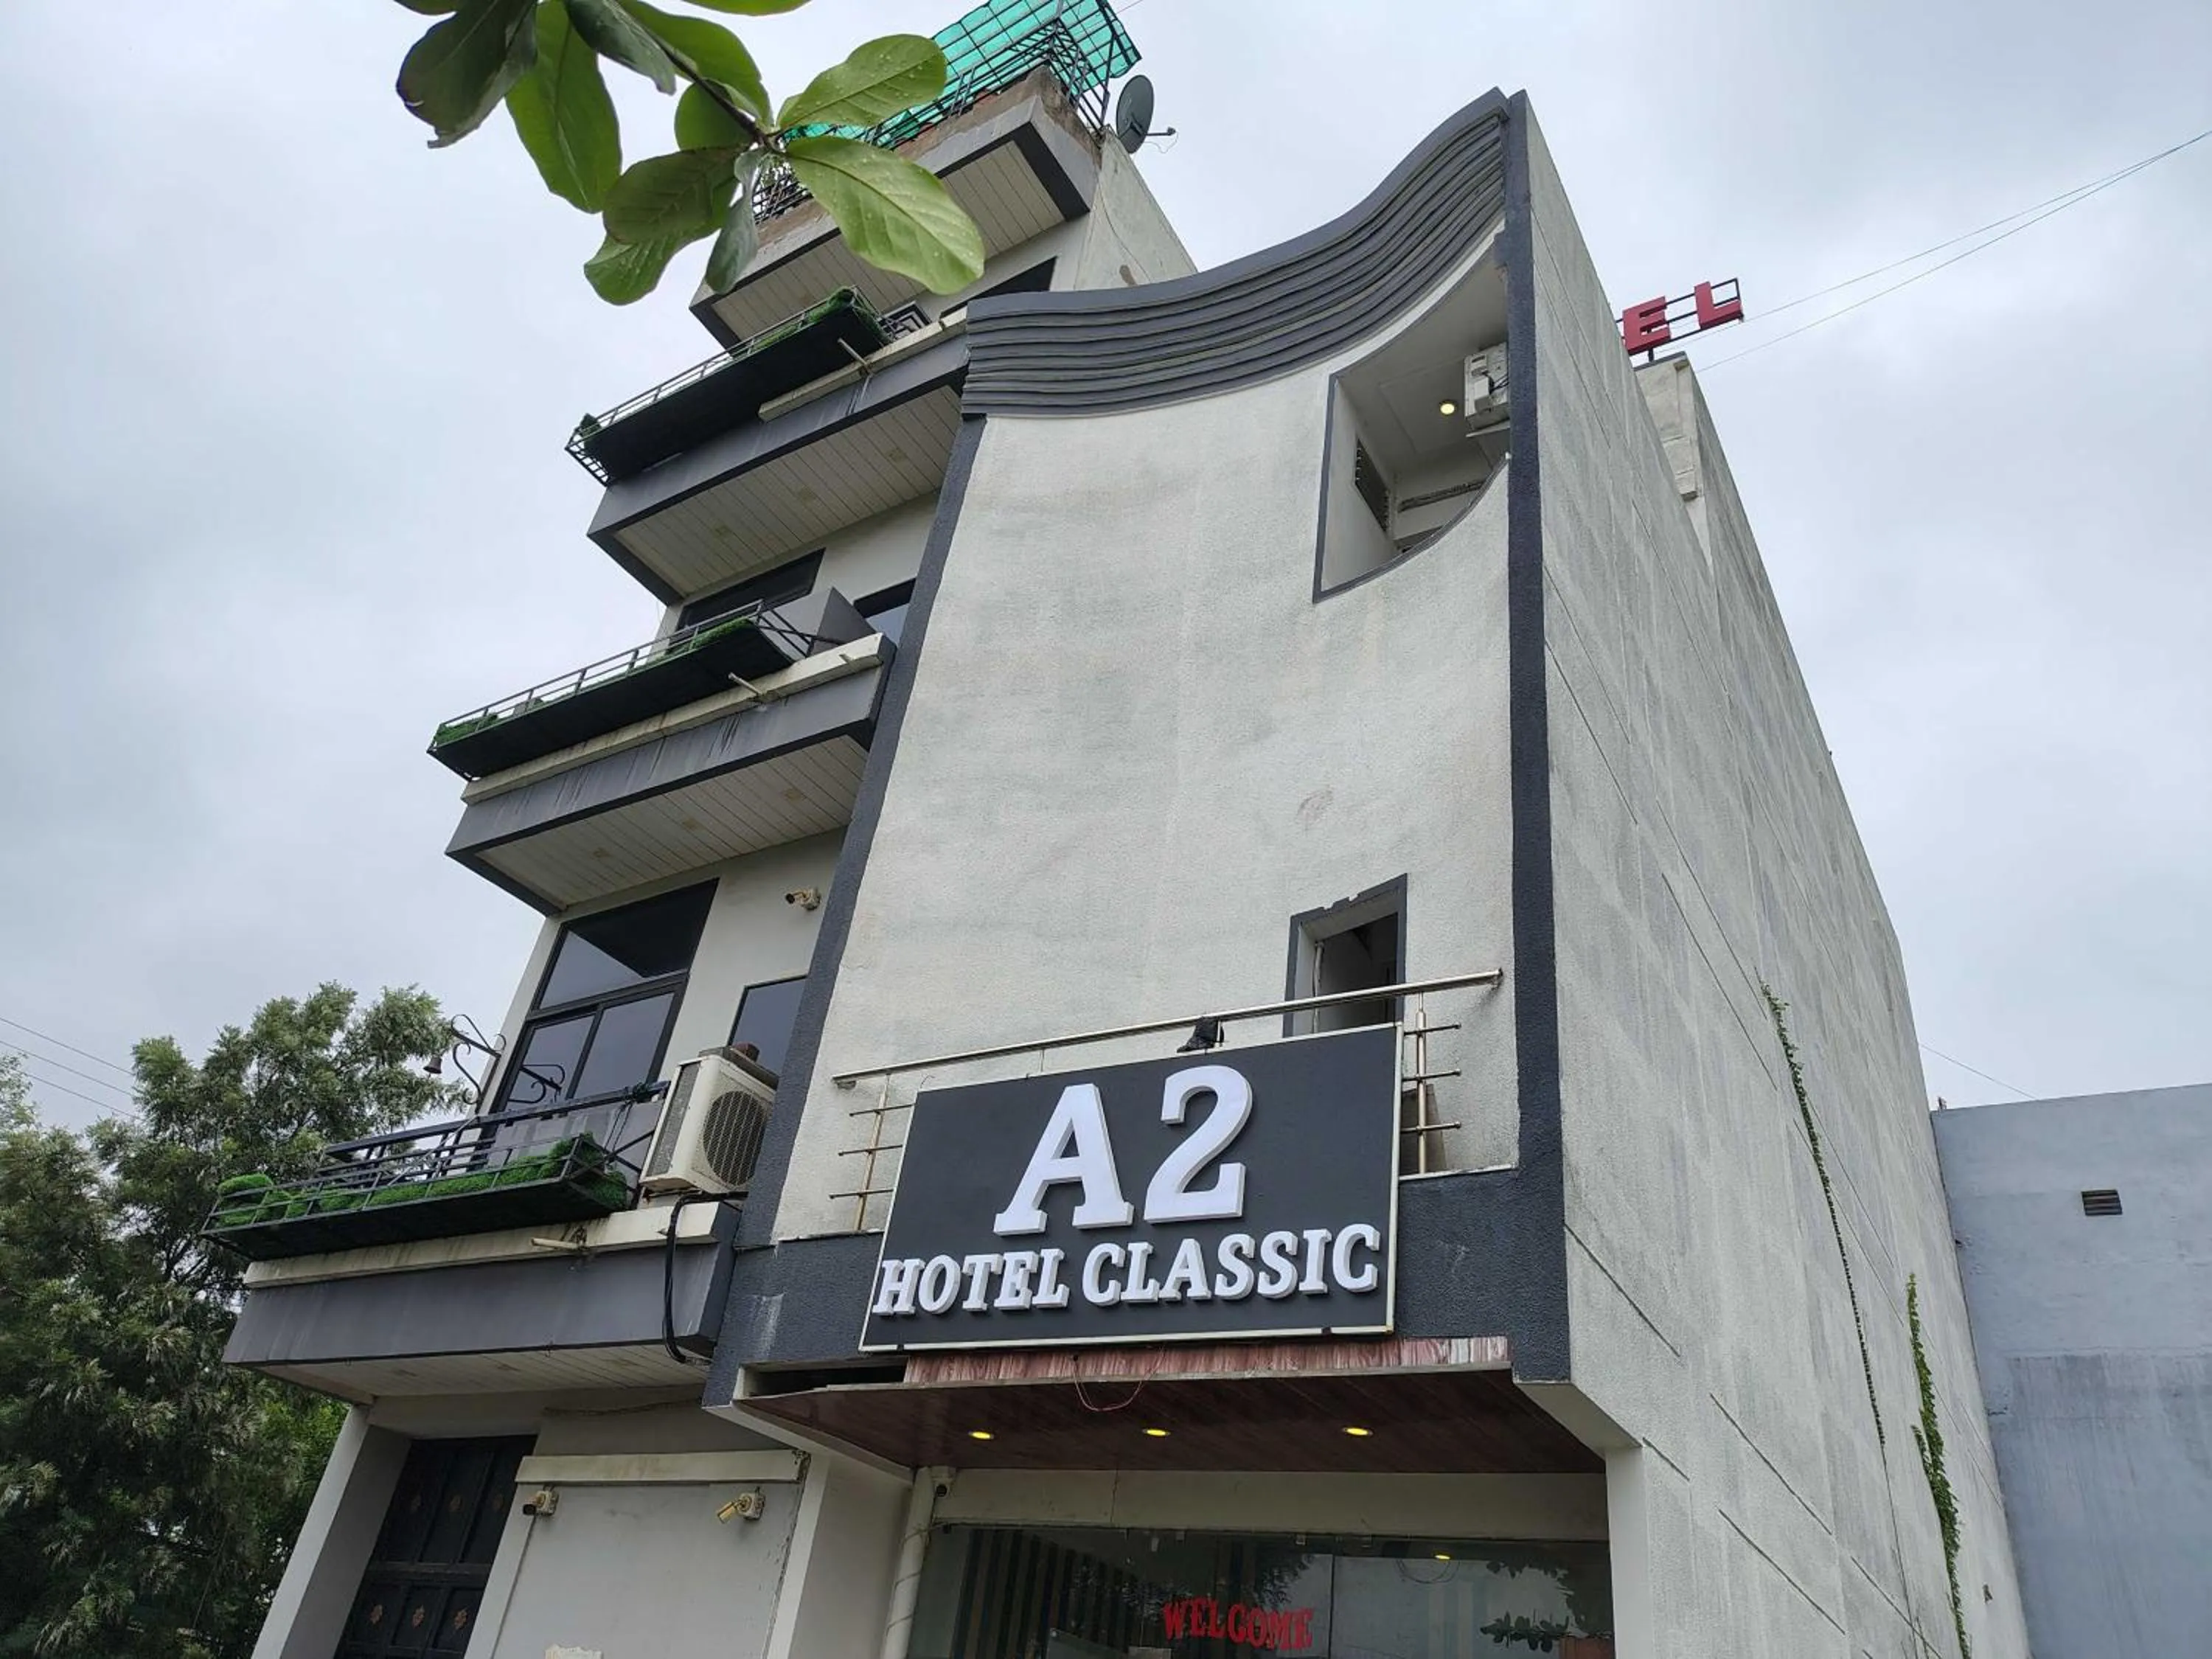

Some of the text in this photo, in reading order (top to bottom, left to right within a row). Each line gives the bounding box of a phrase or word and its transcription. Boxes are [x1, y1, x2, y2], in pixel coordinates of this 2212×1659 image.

[1622, 282, 1742, 355] EL
[994, 1065, 1253, 1236] A2
[872, 1224, 1381, 1315] HOTEL CLASSIC
[1163, 1596, 1315, 1650] WELCOME
